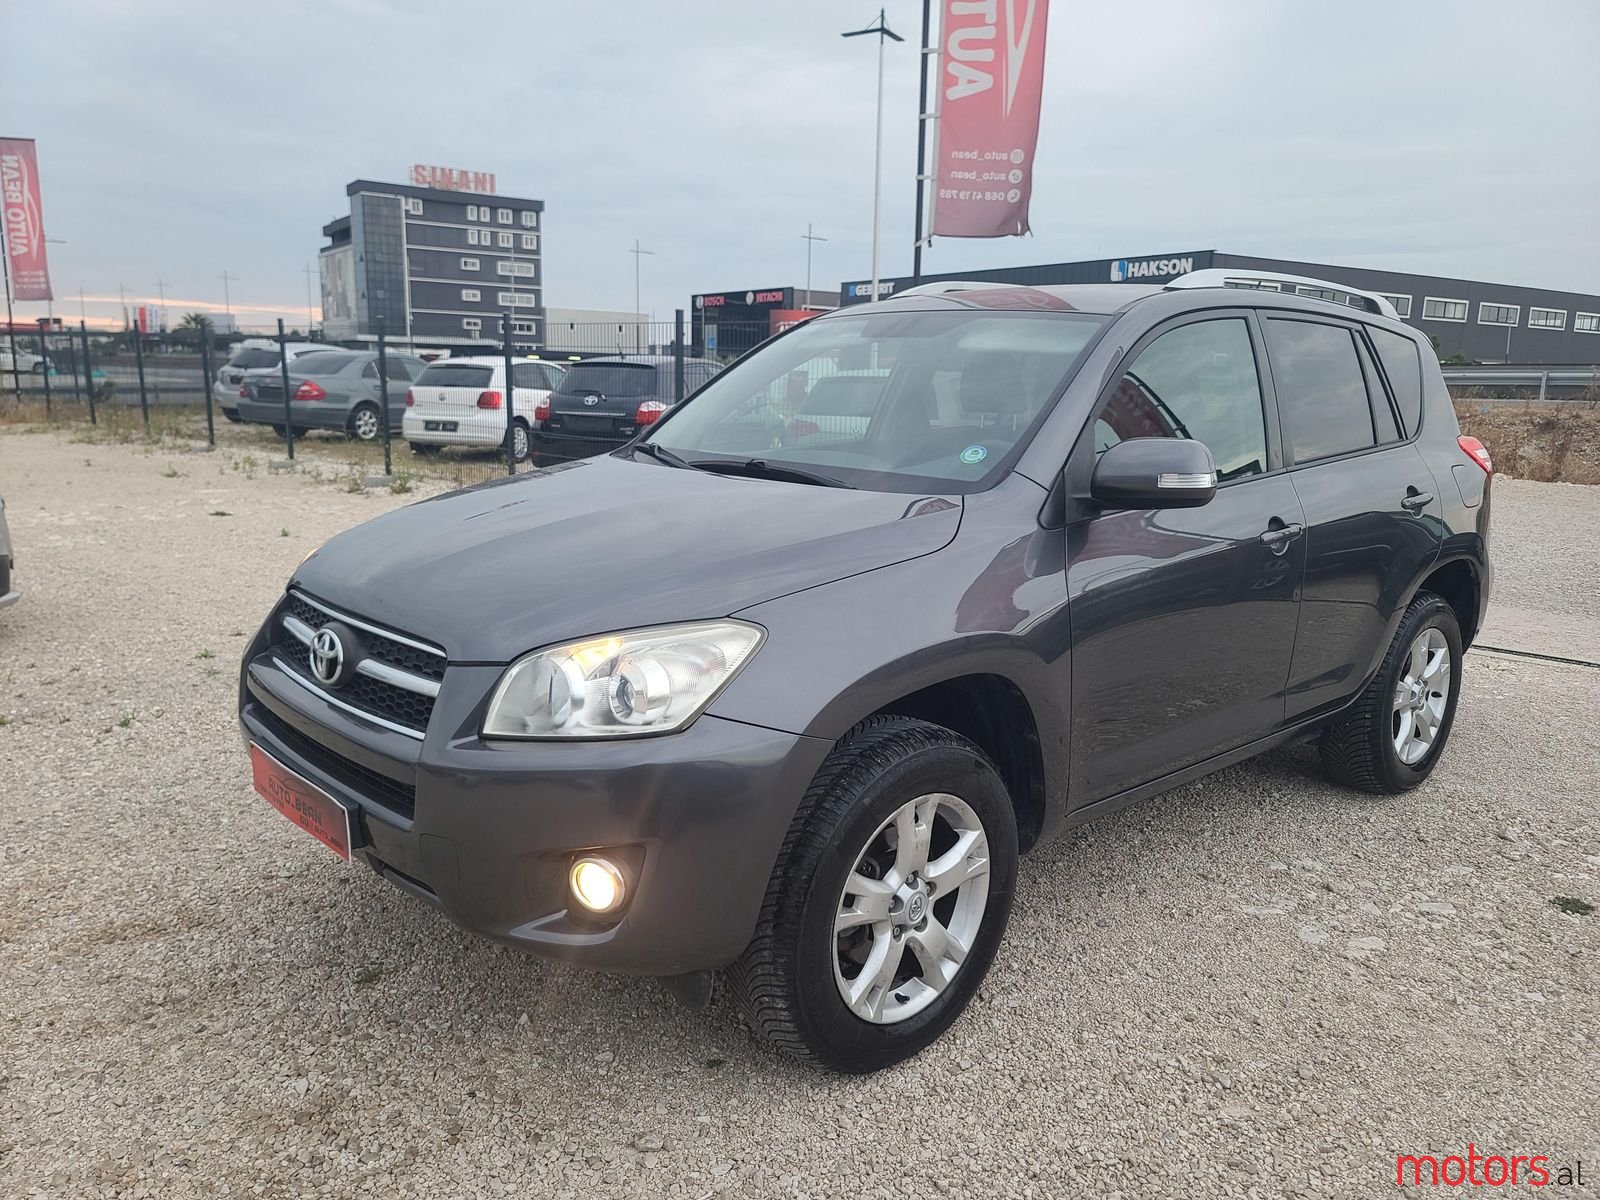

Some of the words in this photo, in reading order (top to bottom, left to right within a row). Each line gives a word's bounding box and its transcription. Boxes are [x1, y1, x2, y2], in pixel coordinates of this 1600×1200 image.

[414, 164, 496, 193] SINANI
[1127, 257, 1193, 278] HAKSON
[756, 291, 784, 303] HITACHI
[855, 282, 896, 297] GEBRIT
[704, 295, 725, 306] BOSCH
